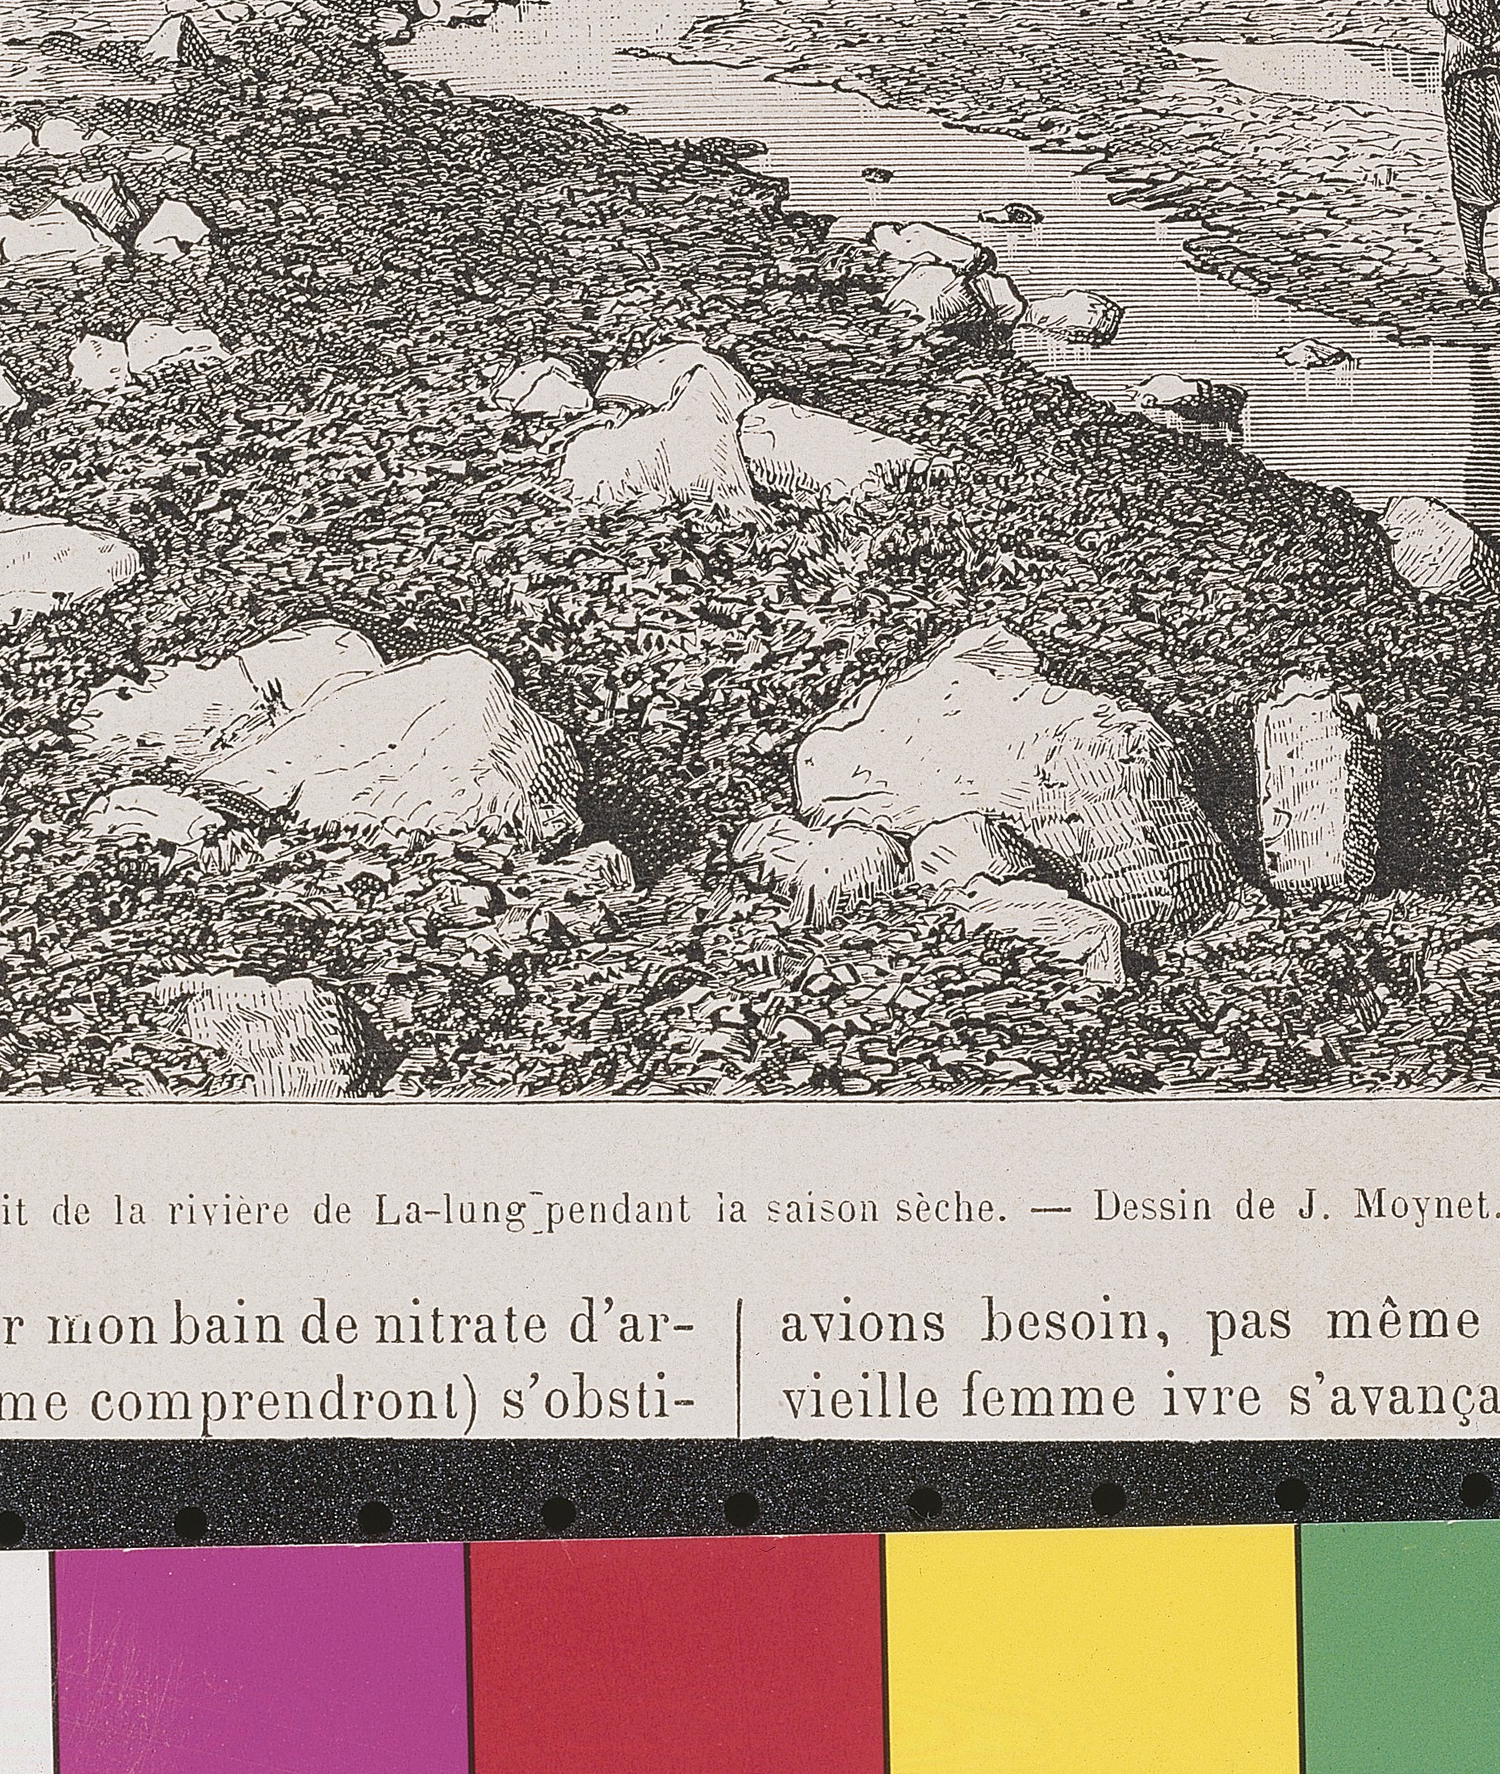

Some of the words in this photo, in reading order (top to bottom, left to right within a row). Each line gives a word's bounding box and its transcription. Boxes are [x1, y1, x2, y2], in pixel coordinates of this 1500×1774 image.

[52, 1194, 90, 1226] de
[114, 1194, 146, 1225] la
[168, 1193, 289, 1227] rivière
[312, 1193, 352, 1226] de
[375, 1192, 528, 1234] La-lung
[544, 1190, 692, 1235] pendant
[717, 1191, 747, 1223] la
[766, 1189, 879, 1224] saison
[896, 1190, 1006, 1223] sèche.
[1093, 1188, 1212, 1221] Dessin
[1236, 1187, 1275, 1220] de
[1298, 1188, 1330, 1220] J.
[47, 1314, 158, 1345] mon
[169, 1298, 285, 1345] bain
[301, 1297, 358, 1345] de
[374, 1297, 547, 1344] nitrate
[781, 1296, 945, 1343] avions
[981, 1294, 1169, 1348] besoin,
[1205, 1309, 1291, 1357] pas
[1326, 1295, 1480, 1339] même
[91, 1373, 477, 1438] comprendront)
[782, 1371, 938, 1419] vieille
[962, 1369, 1135, 1417] femme
[1163, 1369, 1261, 1416] ivre
